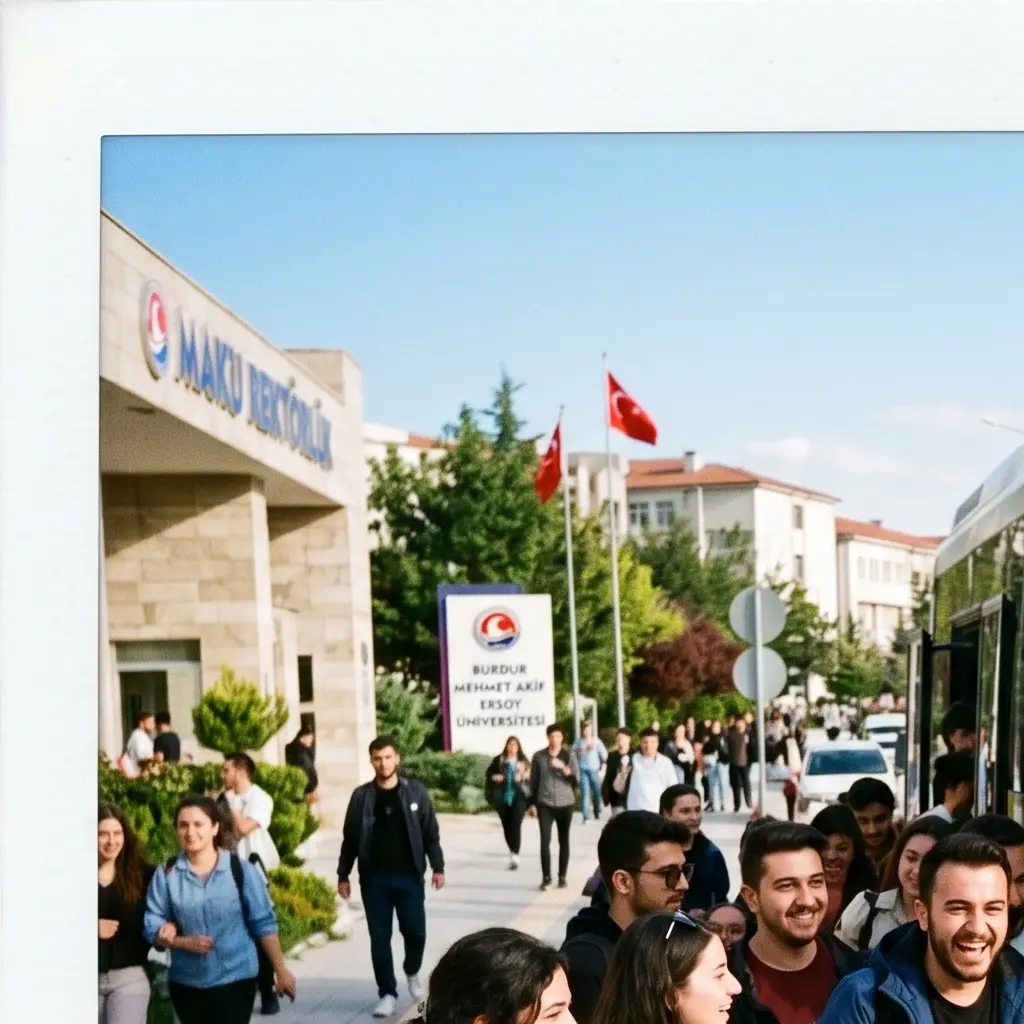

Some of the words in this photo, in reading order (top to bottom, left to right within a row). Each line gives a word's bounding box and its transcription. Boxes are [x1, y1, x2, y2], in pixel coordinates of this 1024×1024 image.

[473, 663, 527, 675] BURDUR
[454, 682, 511, 693] MEHMET
[480, 699, 522, 710] ERSOY
